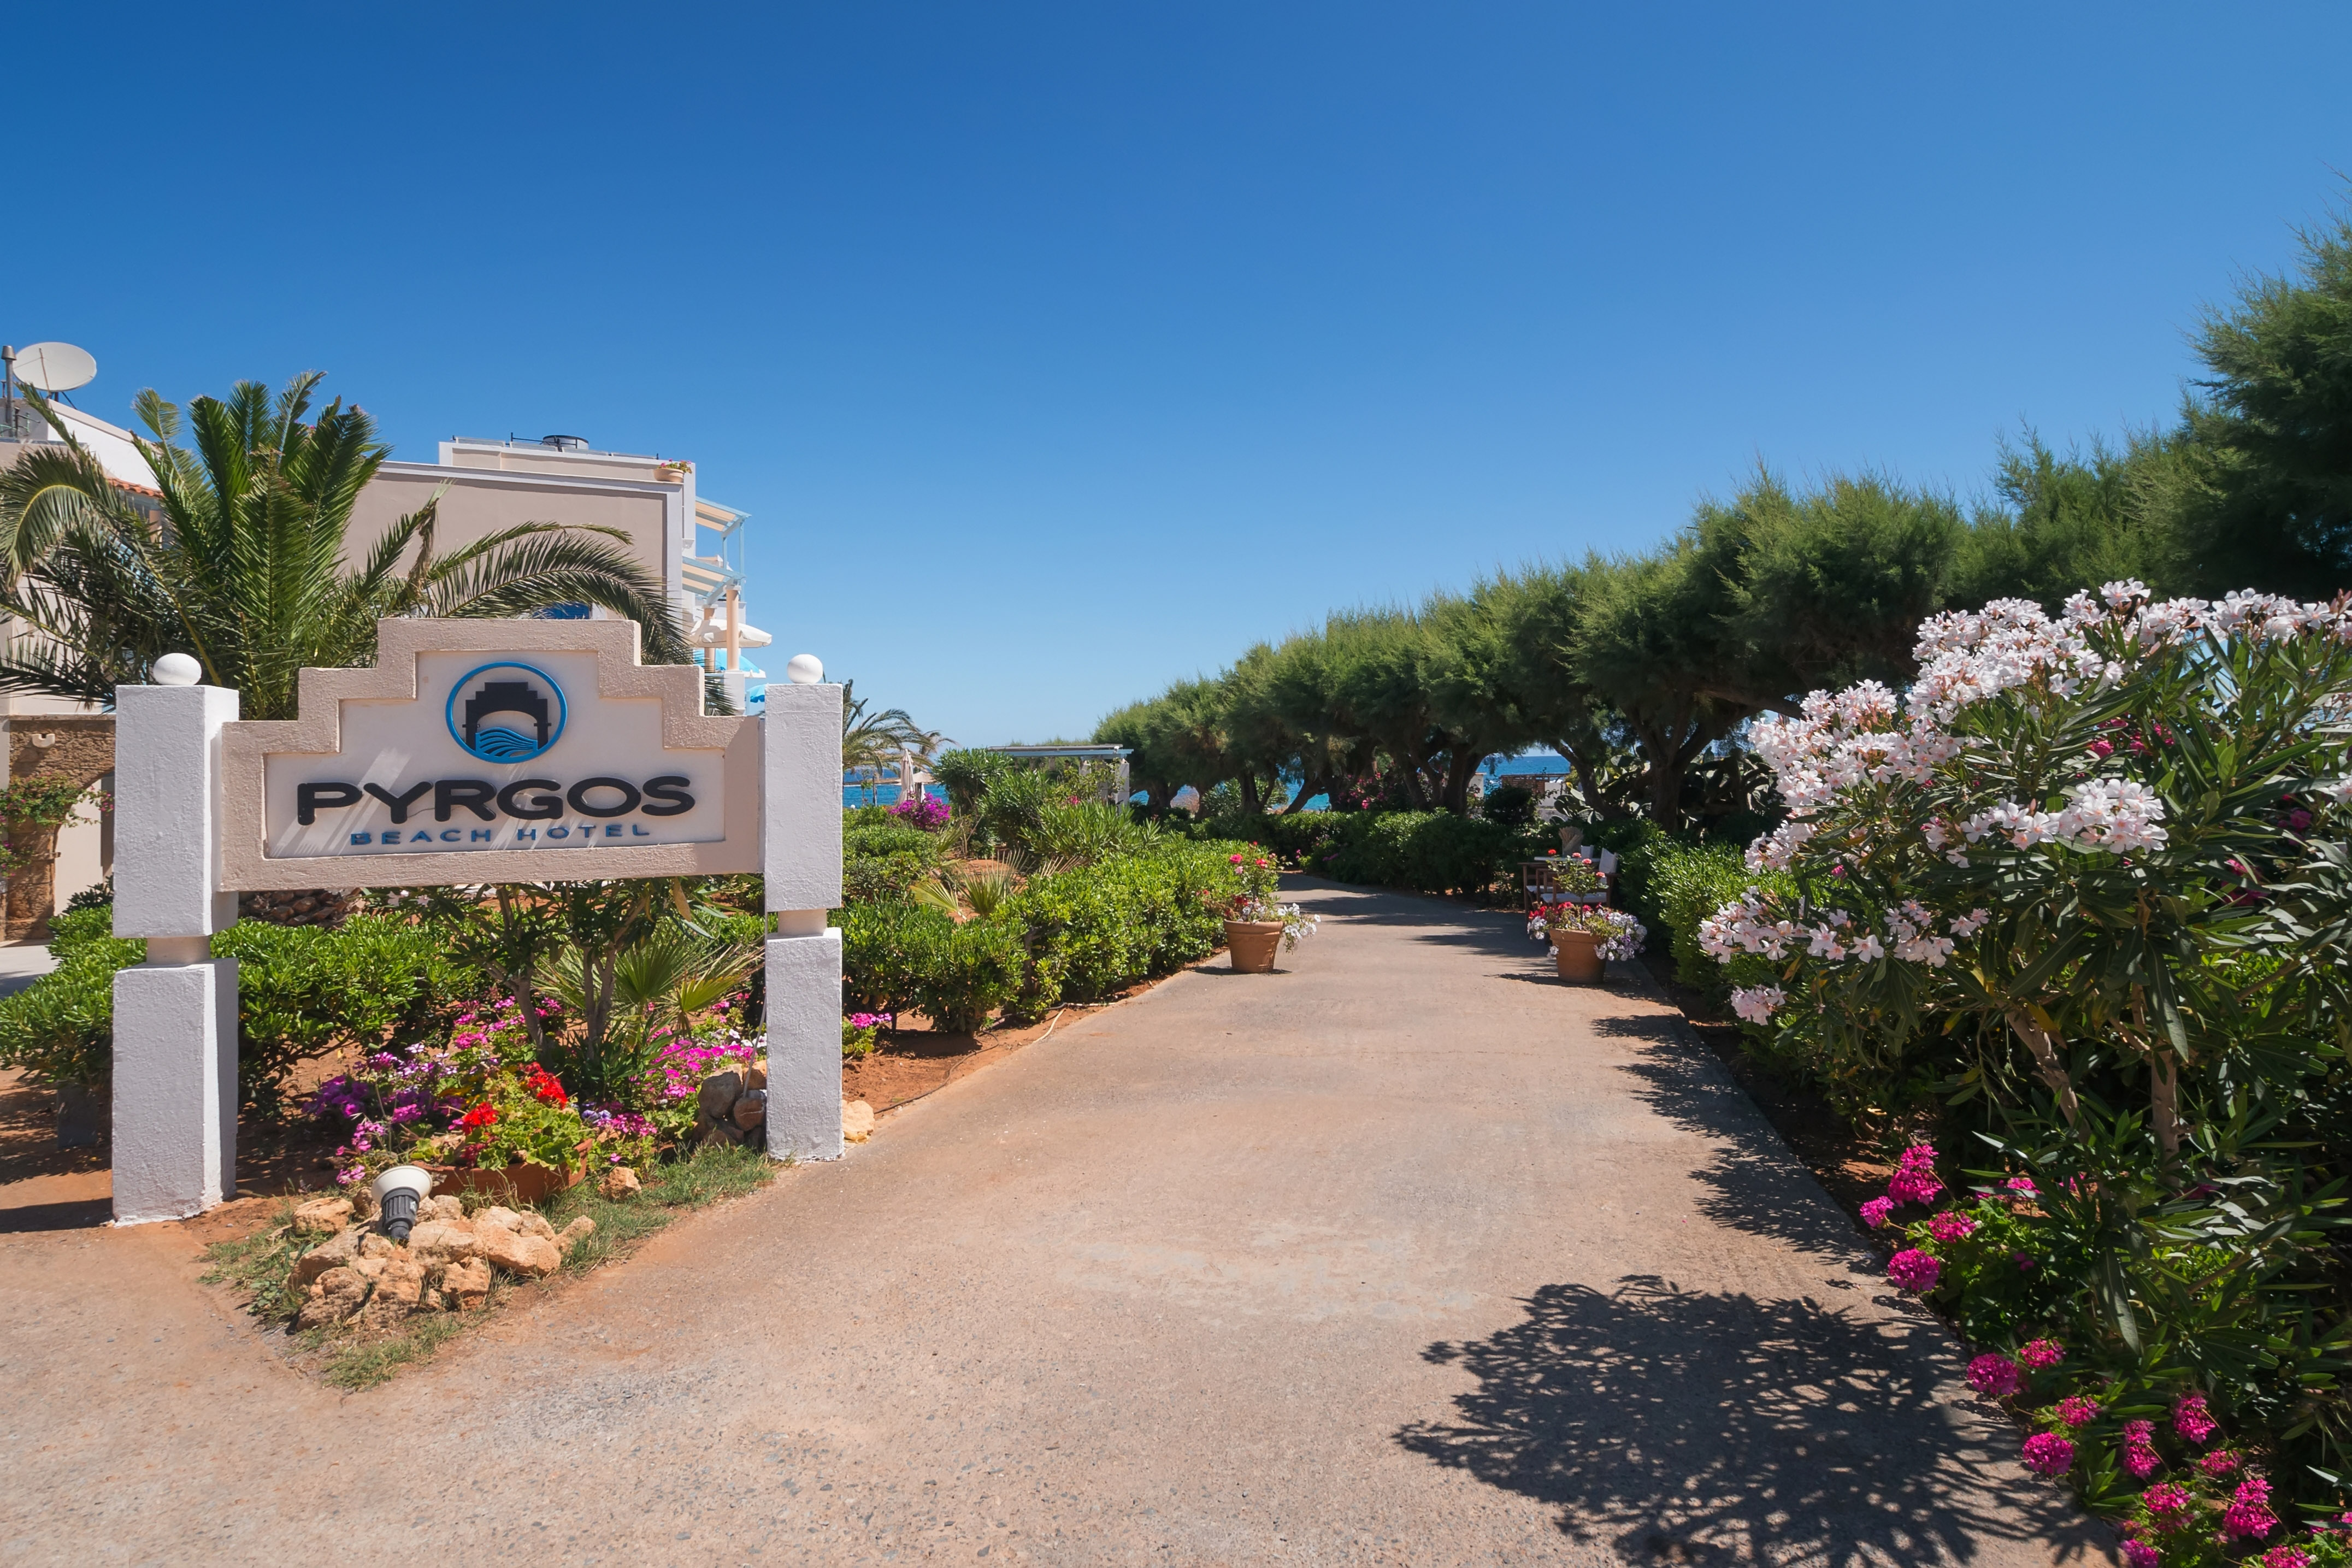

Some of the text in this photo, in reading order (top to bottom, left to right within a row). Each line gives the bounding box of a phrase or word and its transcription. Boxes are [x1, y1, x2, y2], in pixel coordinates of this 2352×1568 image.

[298, 776, 695, 825] PYRGOS
[351, 824, 650, 845] BEACH HOTEL
